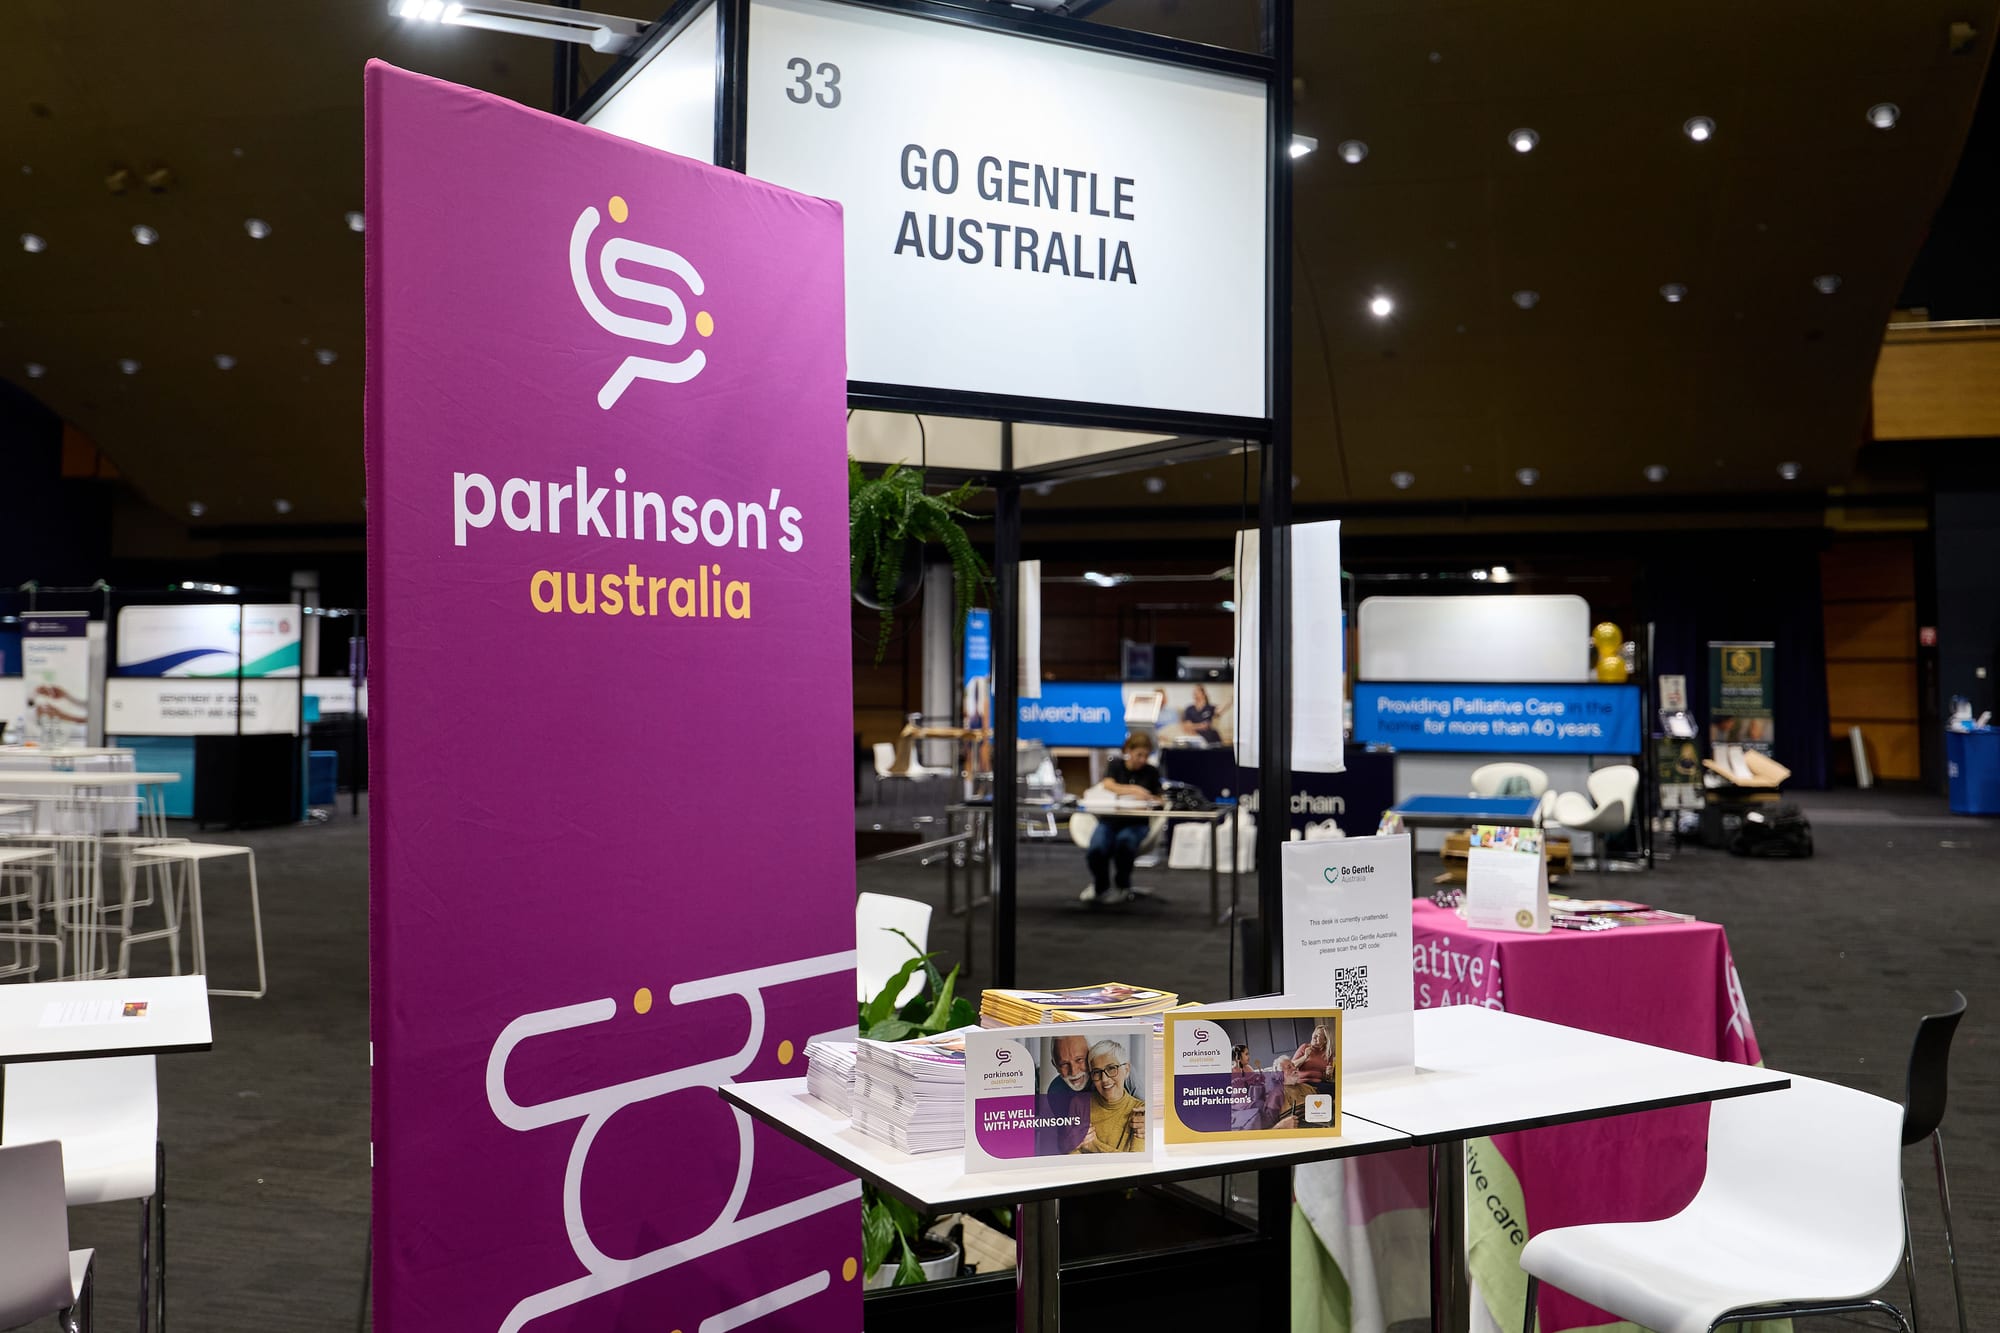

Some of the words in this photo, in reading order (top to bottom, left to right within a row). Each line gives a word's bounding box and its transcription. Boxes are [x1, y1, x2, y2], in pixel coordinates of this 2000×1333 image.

[786, 56, 842, 109] 33
[900, 143, 959, 195] GO
[977, 155, 1136, 221] GENTLE
[894, 210, 1137, 284] AUSTRALIA
[453, 466, 804, 552] parkinson's
[530, 563, 751, 619] australia
[1377, 696, 1450, 717] Providing
[1453, 696, 1524, 716] Palliative
[1525, 698, 1566, 715] Care
[1423, 717, 1446, 735] for
[1449, 720, 1490, 735] more
[1491, 718, 1530, 736] than
[1531, 719, 1556, 736] 40
[1341, 866, 1351, 875] Go
[1352, 864, 1375, 875] Gentle
[1310, 919, 1320, 927] This
[1321, 918, 1333, 926] desk
[1340, 915, 1361, 924] currently
[1309, 938, 1321, 946] learn
[1322, 937, 1335, 945] more
[1413, 936, 1484, 988] ative
[1182, 1048, 1221, 1058] parkinson's
[984, 1069, 1024, 1081] parkinson's
[1182, 1086, 1224, 1096] Palliative
[1225, 1086, 1248, 1095] Care
[1182, 1097, 1200, 1106] and
[1202, 1095, 1252, 1105] Parkinson's
[984, 1110, 1006, 1121] LIVE
[1008, 1108, 1035, 1119] WELL
[984, 1120, 1010, 1132] WITH
[1013, 1116, 1081, 1130] PARKINSON'S
[1486, 1195, 1524, 1245] care
